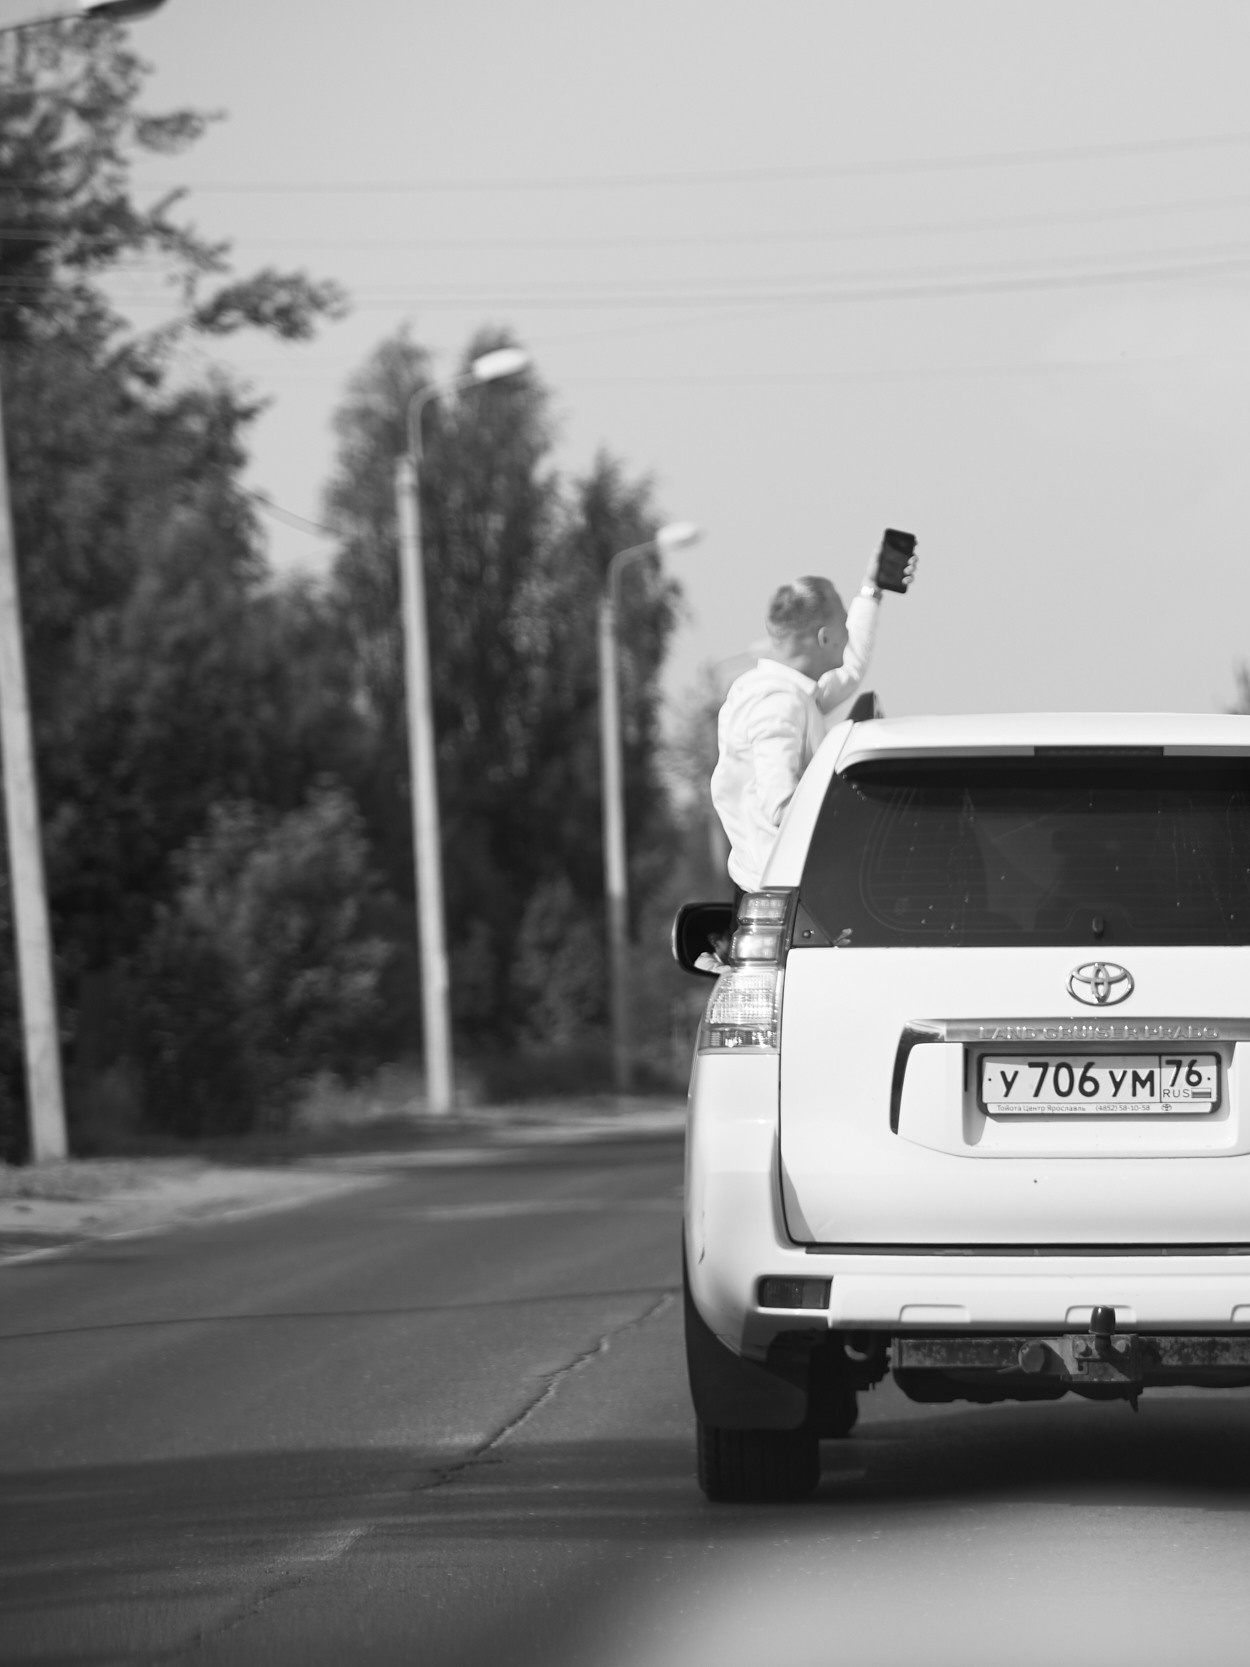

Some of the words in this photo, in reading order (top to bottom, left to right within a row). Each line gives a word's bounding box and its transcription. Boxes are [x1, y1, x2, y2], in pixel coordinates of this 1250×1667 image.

[979, 1025, 1037, 1040] LAND
[1143, 1025, 1219, 1040] PRADO
[1027, 1061, 1100, 1097] 706
[1165, 1059, 1203, 1088] 76
[1162, 1088, 1190, 1098] RUS
[997, 1104, 1021, 1112] Тойота
[1023, 1104, 1046, 1113] Центр
[1047, 1104, 1086, 1113] Ярославль
[1119, 1104, 1151, 1112] 58-10-58
